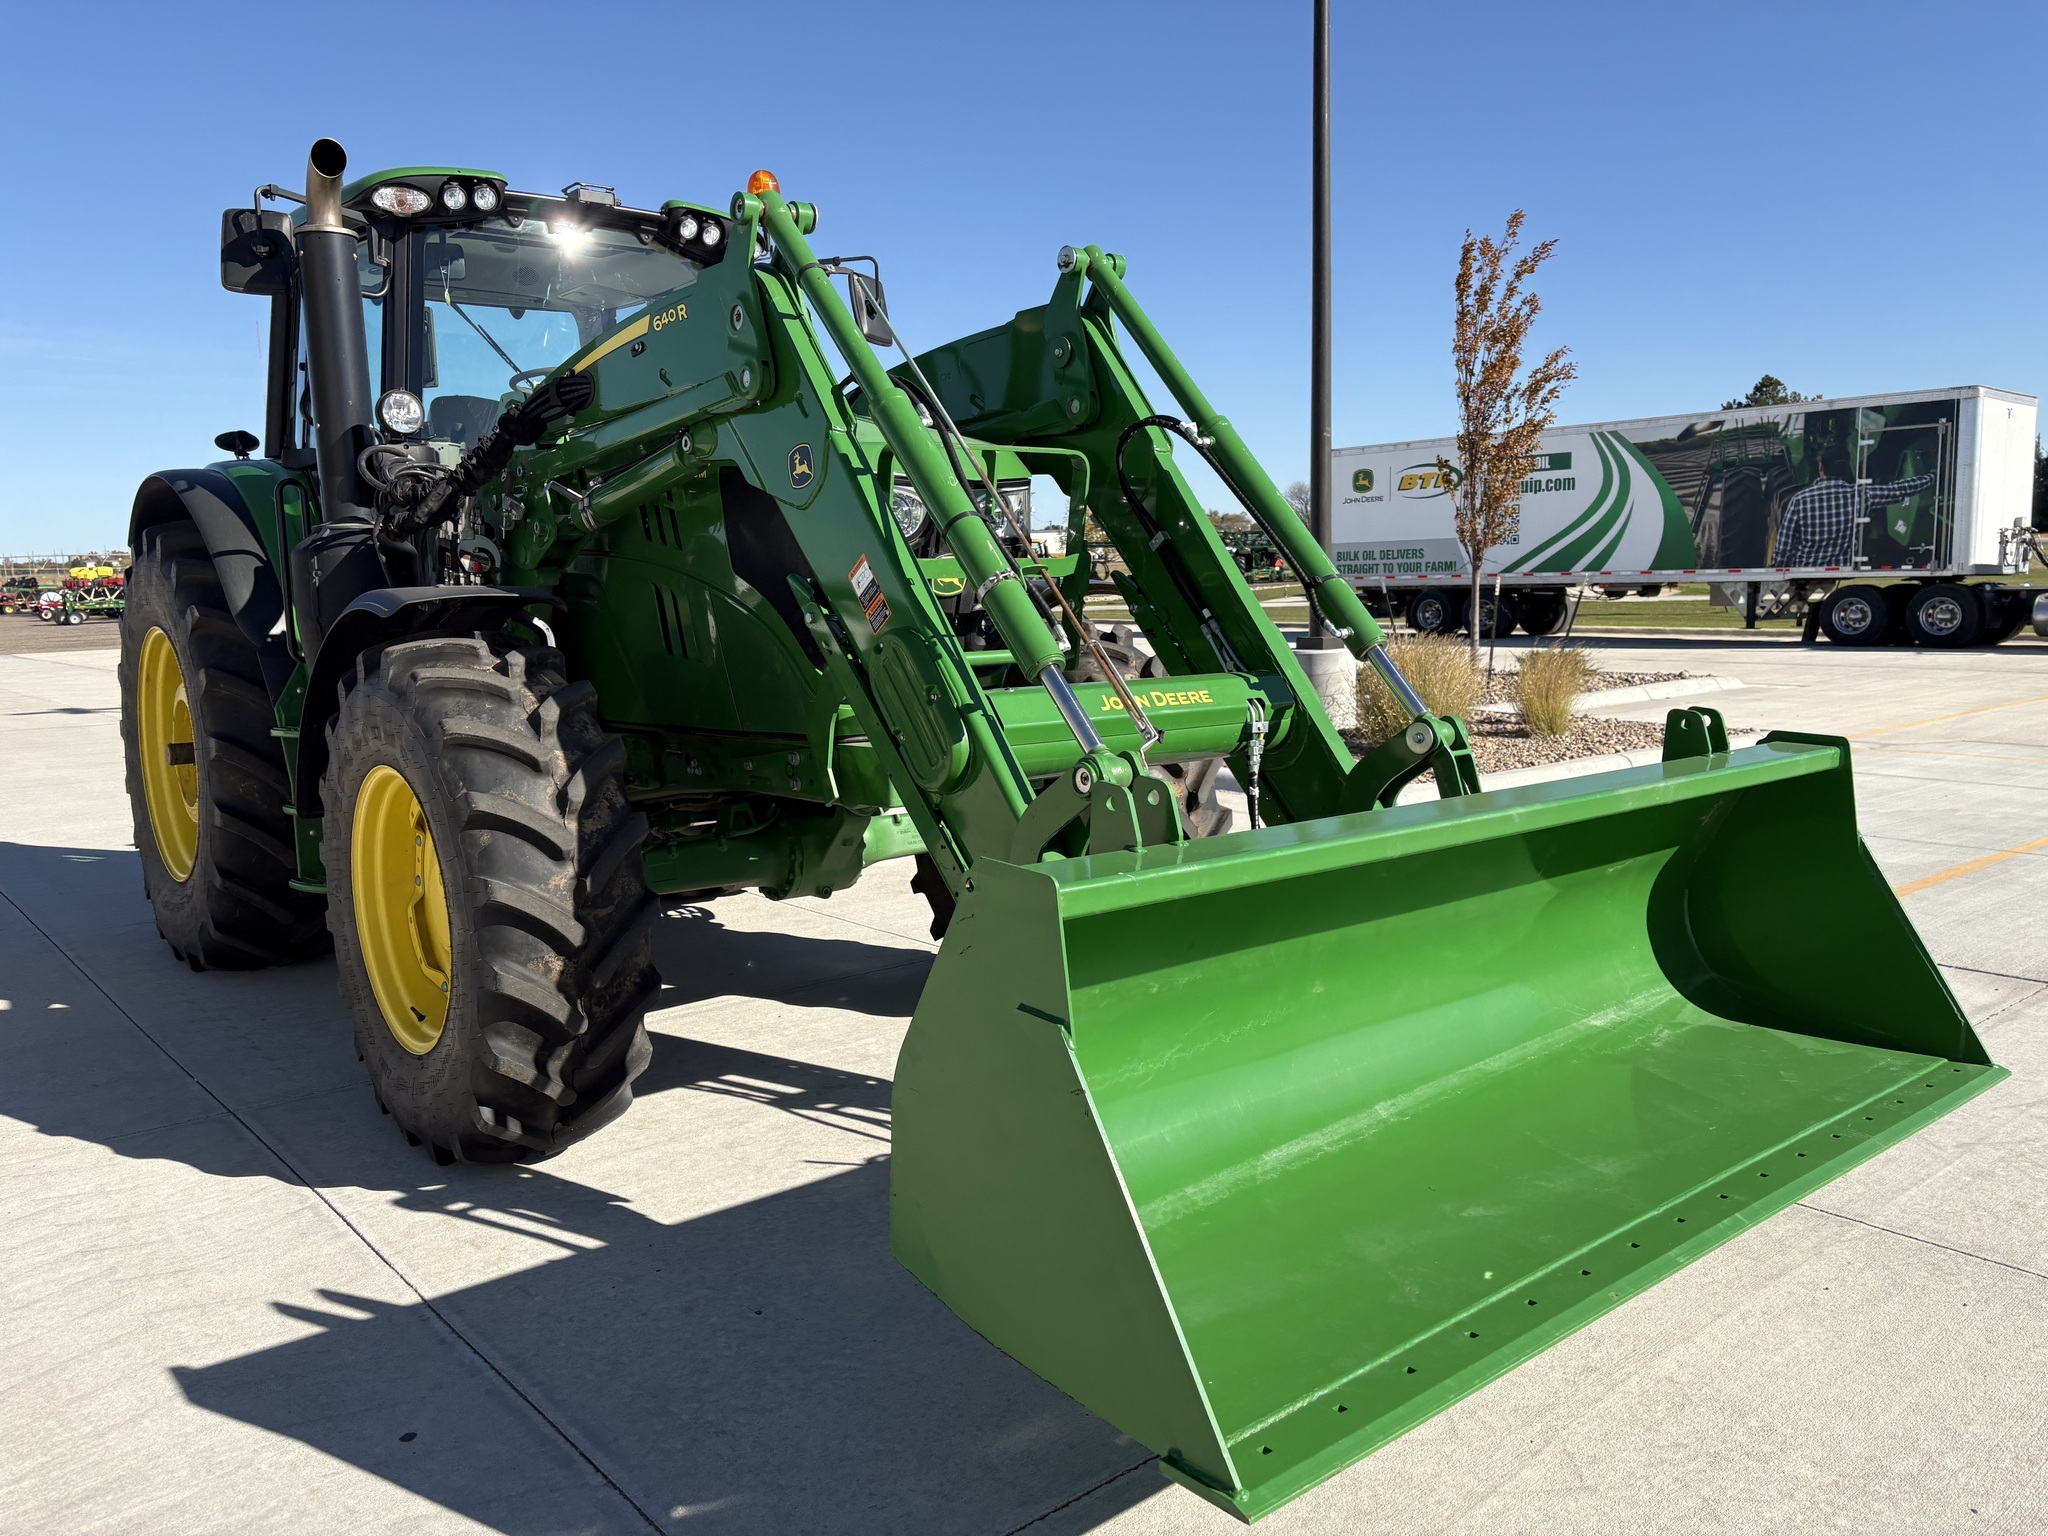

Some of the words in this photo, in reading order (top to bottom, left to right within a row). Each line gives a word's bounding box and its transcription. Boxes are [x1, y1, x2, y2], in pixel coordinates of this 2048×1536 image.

[1342, 497, 1361, 505] JOHN
[1361, 495, 1385, 503] DEERE
[1336, 551, 1360, 562] BULK
[1362, 550, 1377, 561] OIL
[1379, 548, 1425, 561] DELIVERS
[1336, 563, 1380, 574] STRAIGHT
[1383, 562, 1394, 574] TO
[1397, 561, 1422, 573] YOUR
[1425, 561, 1457, 572] FARM!
[1101, 694, 1151, 711] JON
[1150, 690, 1213, 707] DEERE
